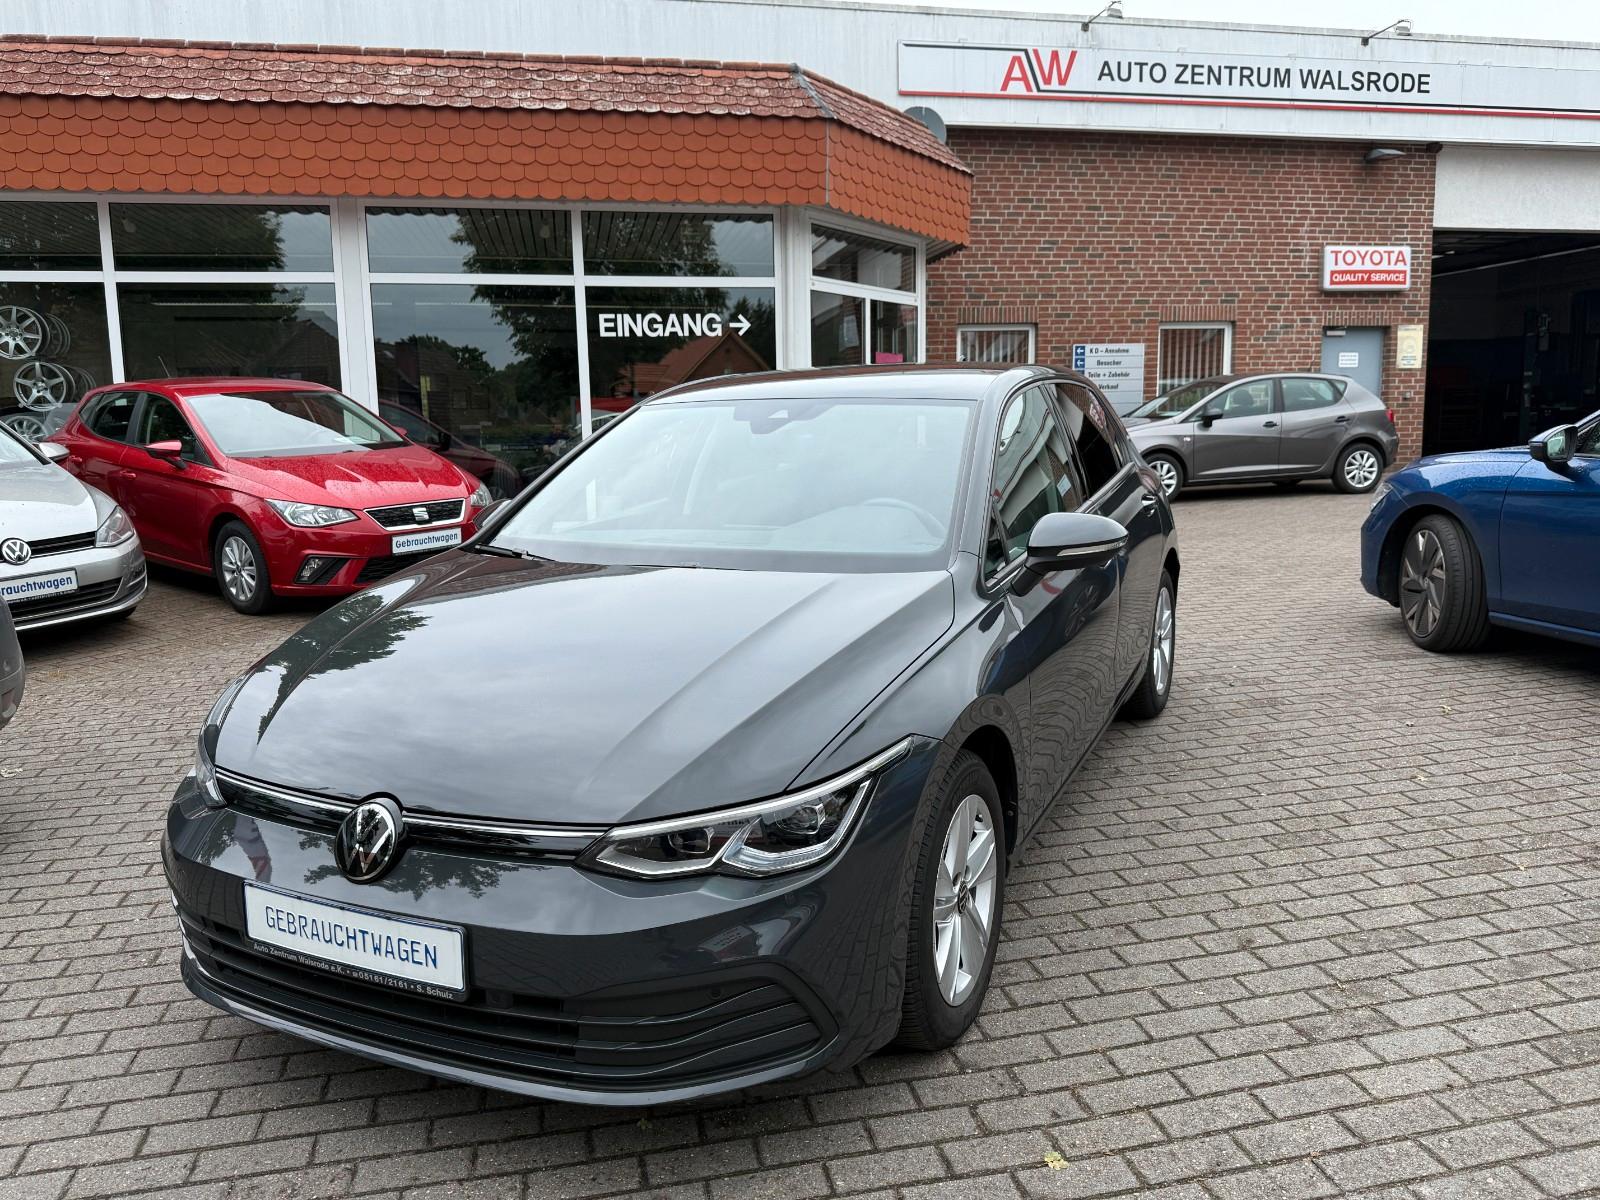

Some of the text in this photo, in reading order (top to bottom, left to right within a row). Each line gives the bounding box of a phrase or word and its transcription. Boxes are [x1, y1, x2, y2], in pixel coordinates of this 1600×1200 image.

[1000, 48, 1078, 93] AW
[1097, 60, 1431, 94] AUTO ZENTRUM WALSRODE
[1330, 249, 1408, 267] TOYOTA
[1332, 272, 1405, 282] QUALITY SERVICE
[598, 312, 723, 338] EINGANG
[395, 532, 458, 549] Gebrauchtwagen
[0, 576, 73, 596] rauchtwagen
[265, 905, 438, 970] GEBRAUCHTWAGEN
[253, 942, 269, 953] Auto
[270, 947, 298, 962] Zentrum
[299, 955, 330, 970] Walsrode
[416, 984, 425, 993] S.
[426, 986, 454, 1000] Schulz
